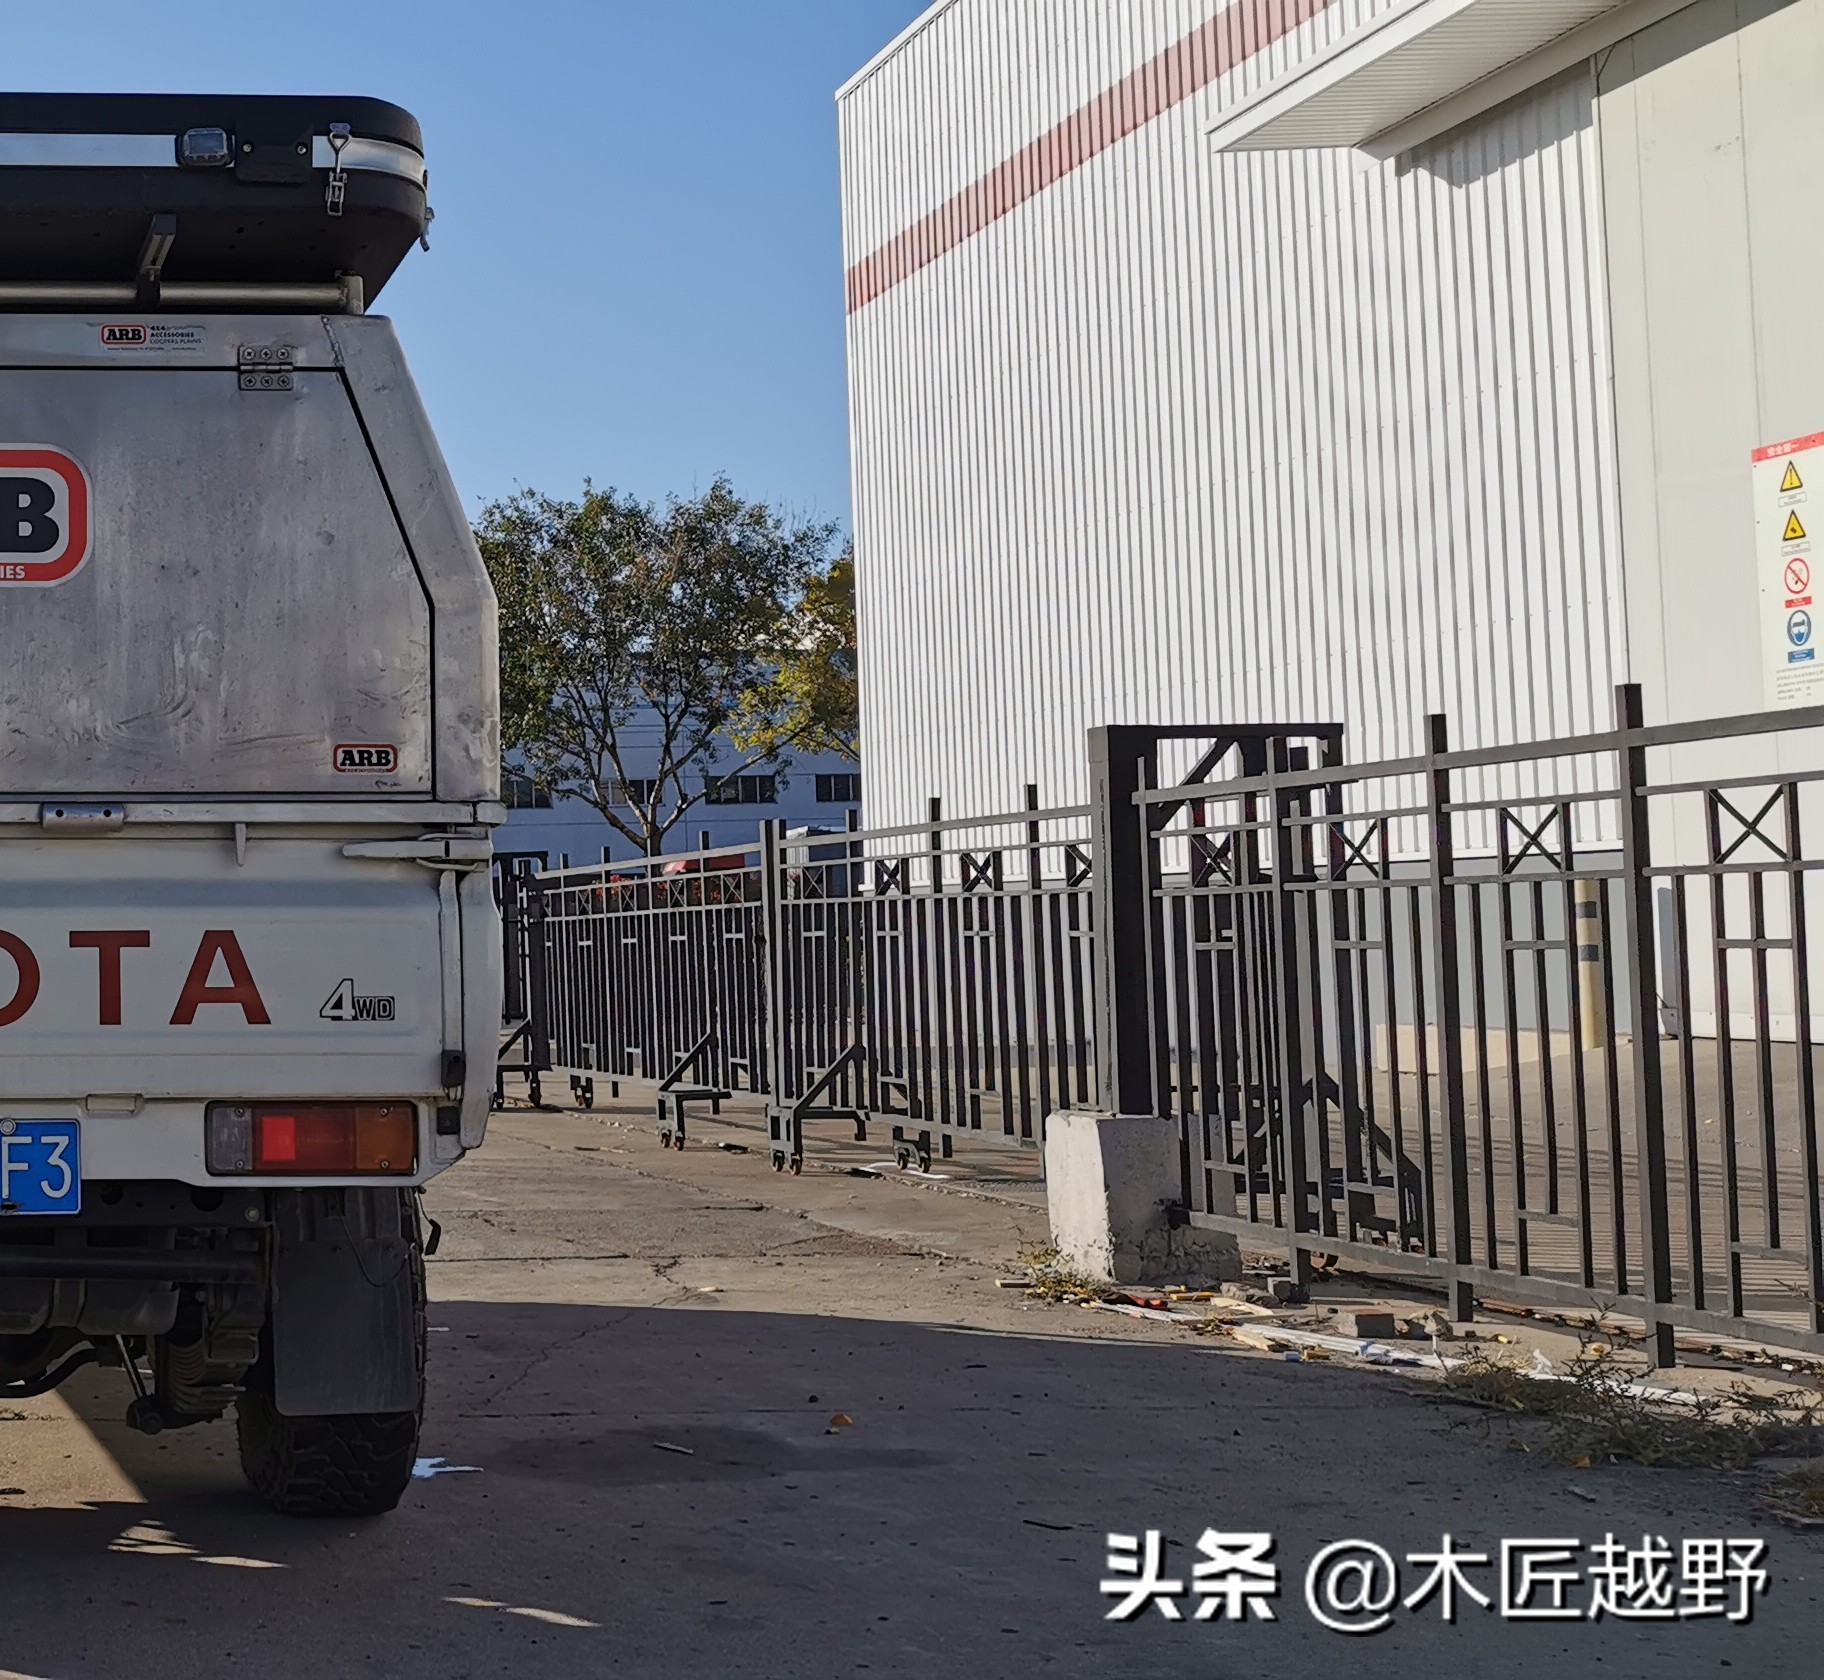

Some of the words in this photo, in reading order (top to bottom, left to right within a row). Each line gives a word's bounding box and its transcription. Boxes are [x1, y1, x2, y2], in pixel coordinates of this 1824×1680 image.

[106, 328, 142, 341] ARB
[339, 749, 392, 767] ARB
[319, 978, 395, 1021] 4WD
